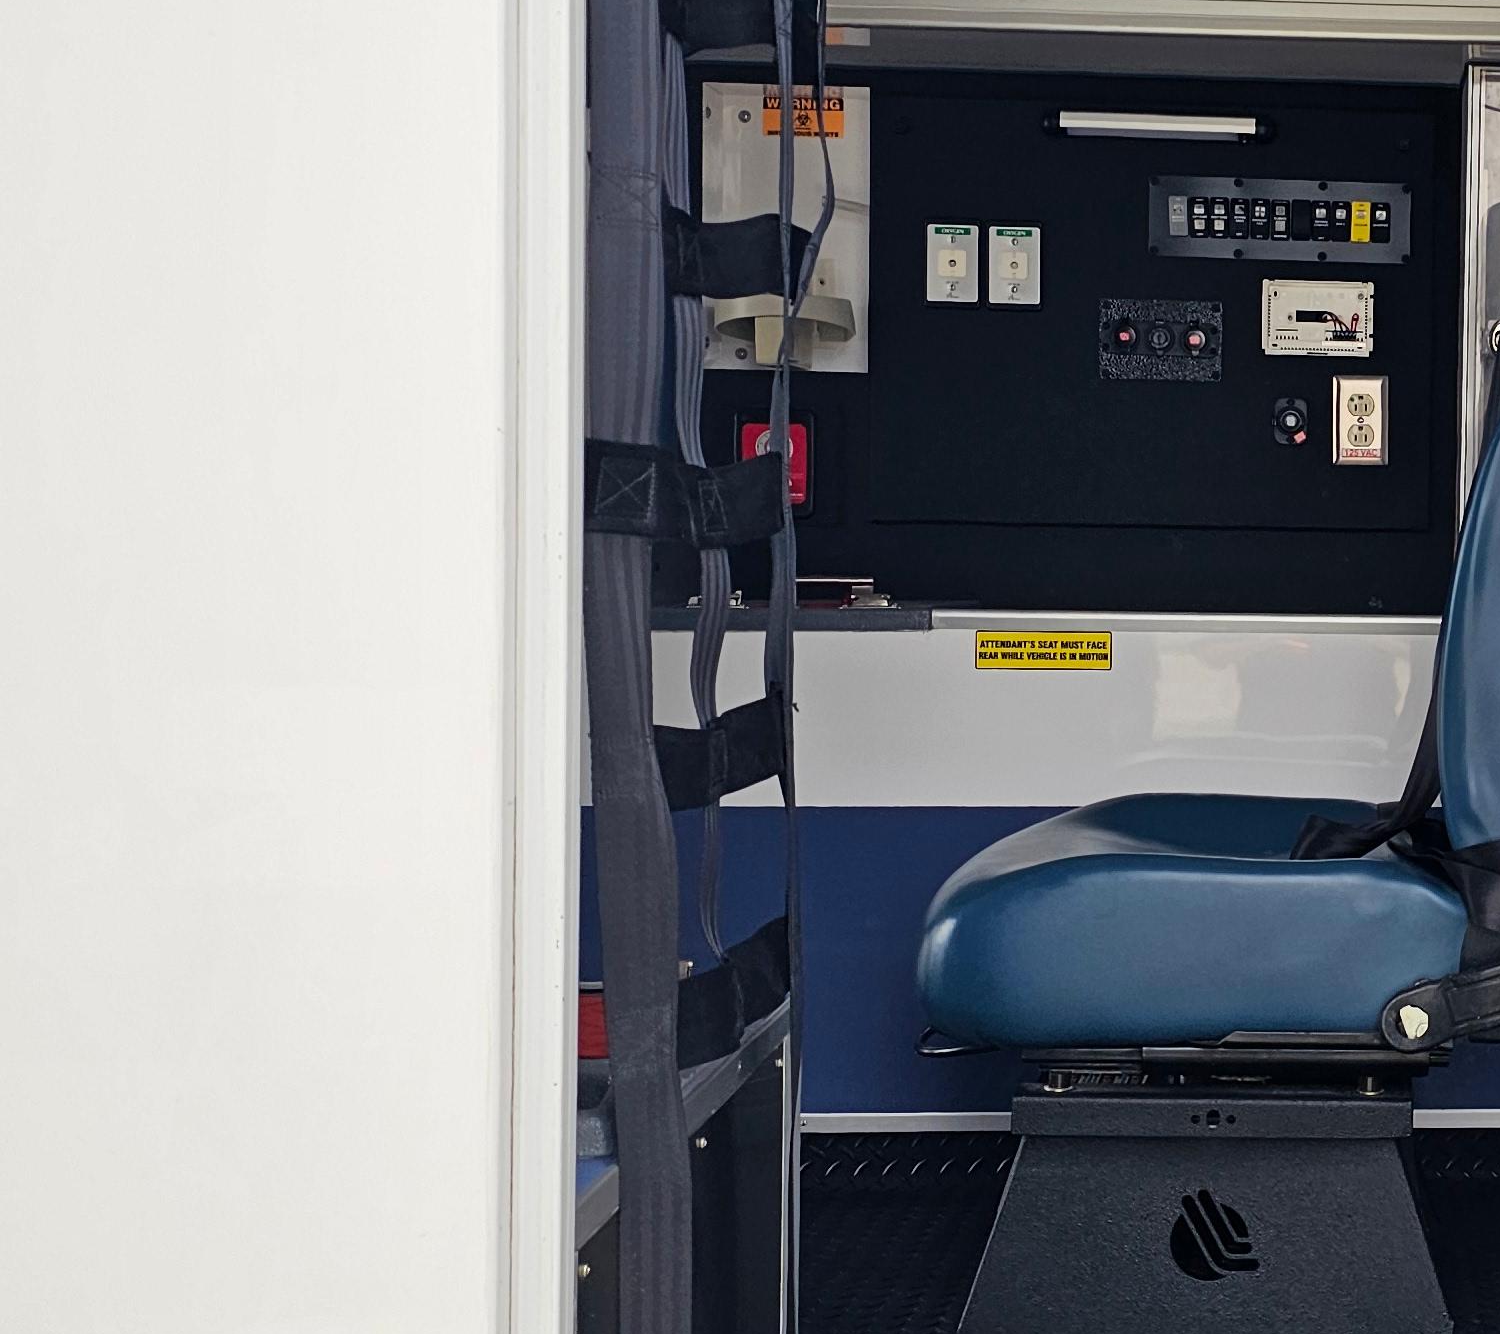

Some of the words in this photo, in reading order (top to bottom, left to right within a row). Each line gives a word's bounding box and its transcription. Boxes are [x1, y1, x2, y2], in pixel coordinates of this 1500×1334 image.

[1345, 449, 1359, 457] 125
[1361, 449, 1377, 457] VAC
[979, 640, 1036, 649] ATTENDANT'S
[1037, 640, 1059, 649] SEAT
[1060, 641, 1085, 649] MUST
[1086, 641, 1108, 650] FACE
[978, 652, 999, 660] REAR
[1000, 652, 1025, 660] WHILE
[1026, 652, 1058, 660] VEHICLE
[1059, 652, 1067, 660] IS
[1068, 652, 1077, 660] IN
[1078, 652, 1109, 661] MOTION
